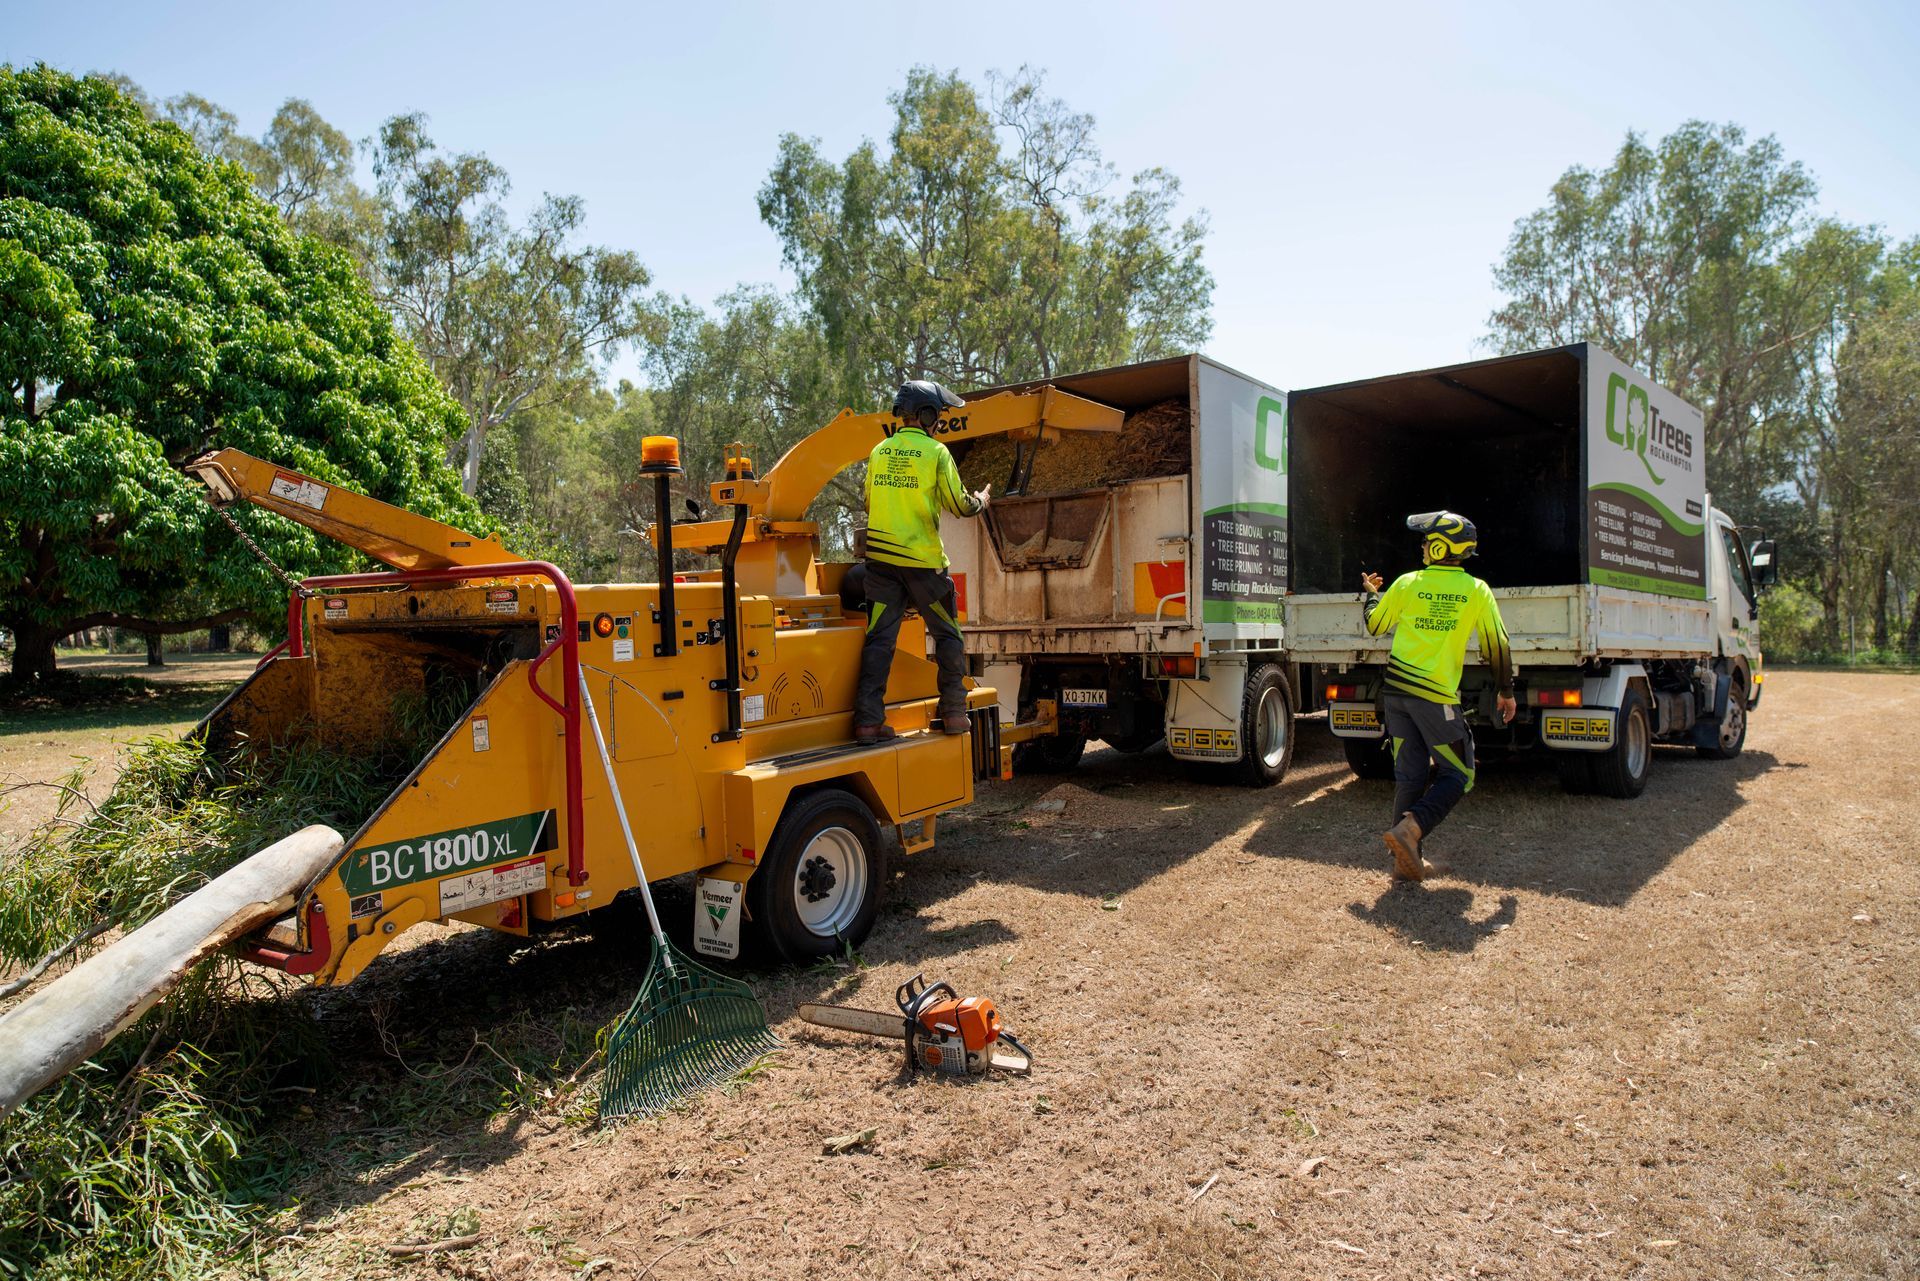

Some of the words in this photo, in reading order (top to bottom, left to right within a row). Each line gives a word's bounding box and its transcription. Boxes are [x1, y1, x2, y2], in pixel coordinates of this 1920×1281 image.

[882, 415, 969, 438] Veer
[1650, 405, 1692, 458] Trees
[894, 449, 922, 457] TREES
[1650, 445, 1692, 472] ROCKHAMPTON
[1217, 520, 1234, 534] TREE
[1235, 523, 1264, 539] REMOVAL
[1217, 539, 1234, 553] TREE
[1235, 541, 1259, 556] FELLING
[1217, 558, 1234, 572] TREE
[1235, 560, 1263, 575] PRUNING
[1211, 578, 1250, 596] Servicing
[1418, 592, 1432, 600] CQ
[1436, 593, 1467, 603] TREES
[1550, 720, 1609, 732] RGM
[1174, 732, 1235, 746] RGM
[1546, 735, 1610, 743] MAINTENANCE
[371, 845, 415, 885] BC
[418, 830, 490, 873] 1800
[493, 832, 518, 857] XL
[702, 890, 733, 904] Vermeer
[699, 937, 733, 949] VERMEER.COM.AU
[702, 944, 711, 952] 1300
[712, 946, 731, 954] VERMEER
